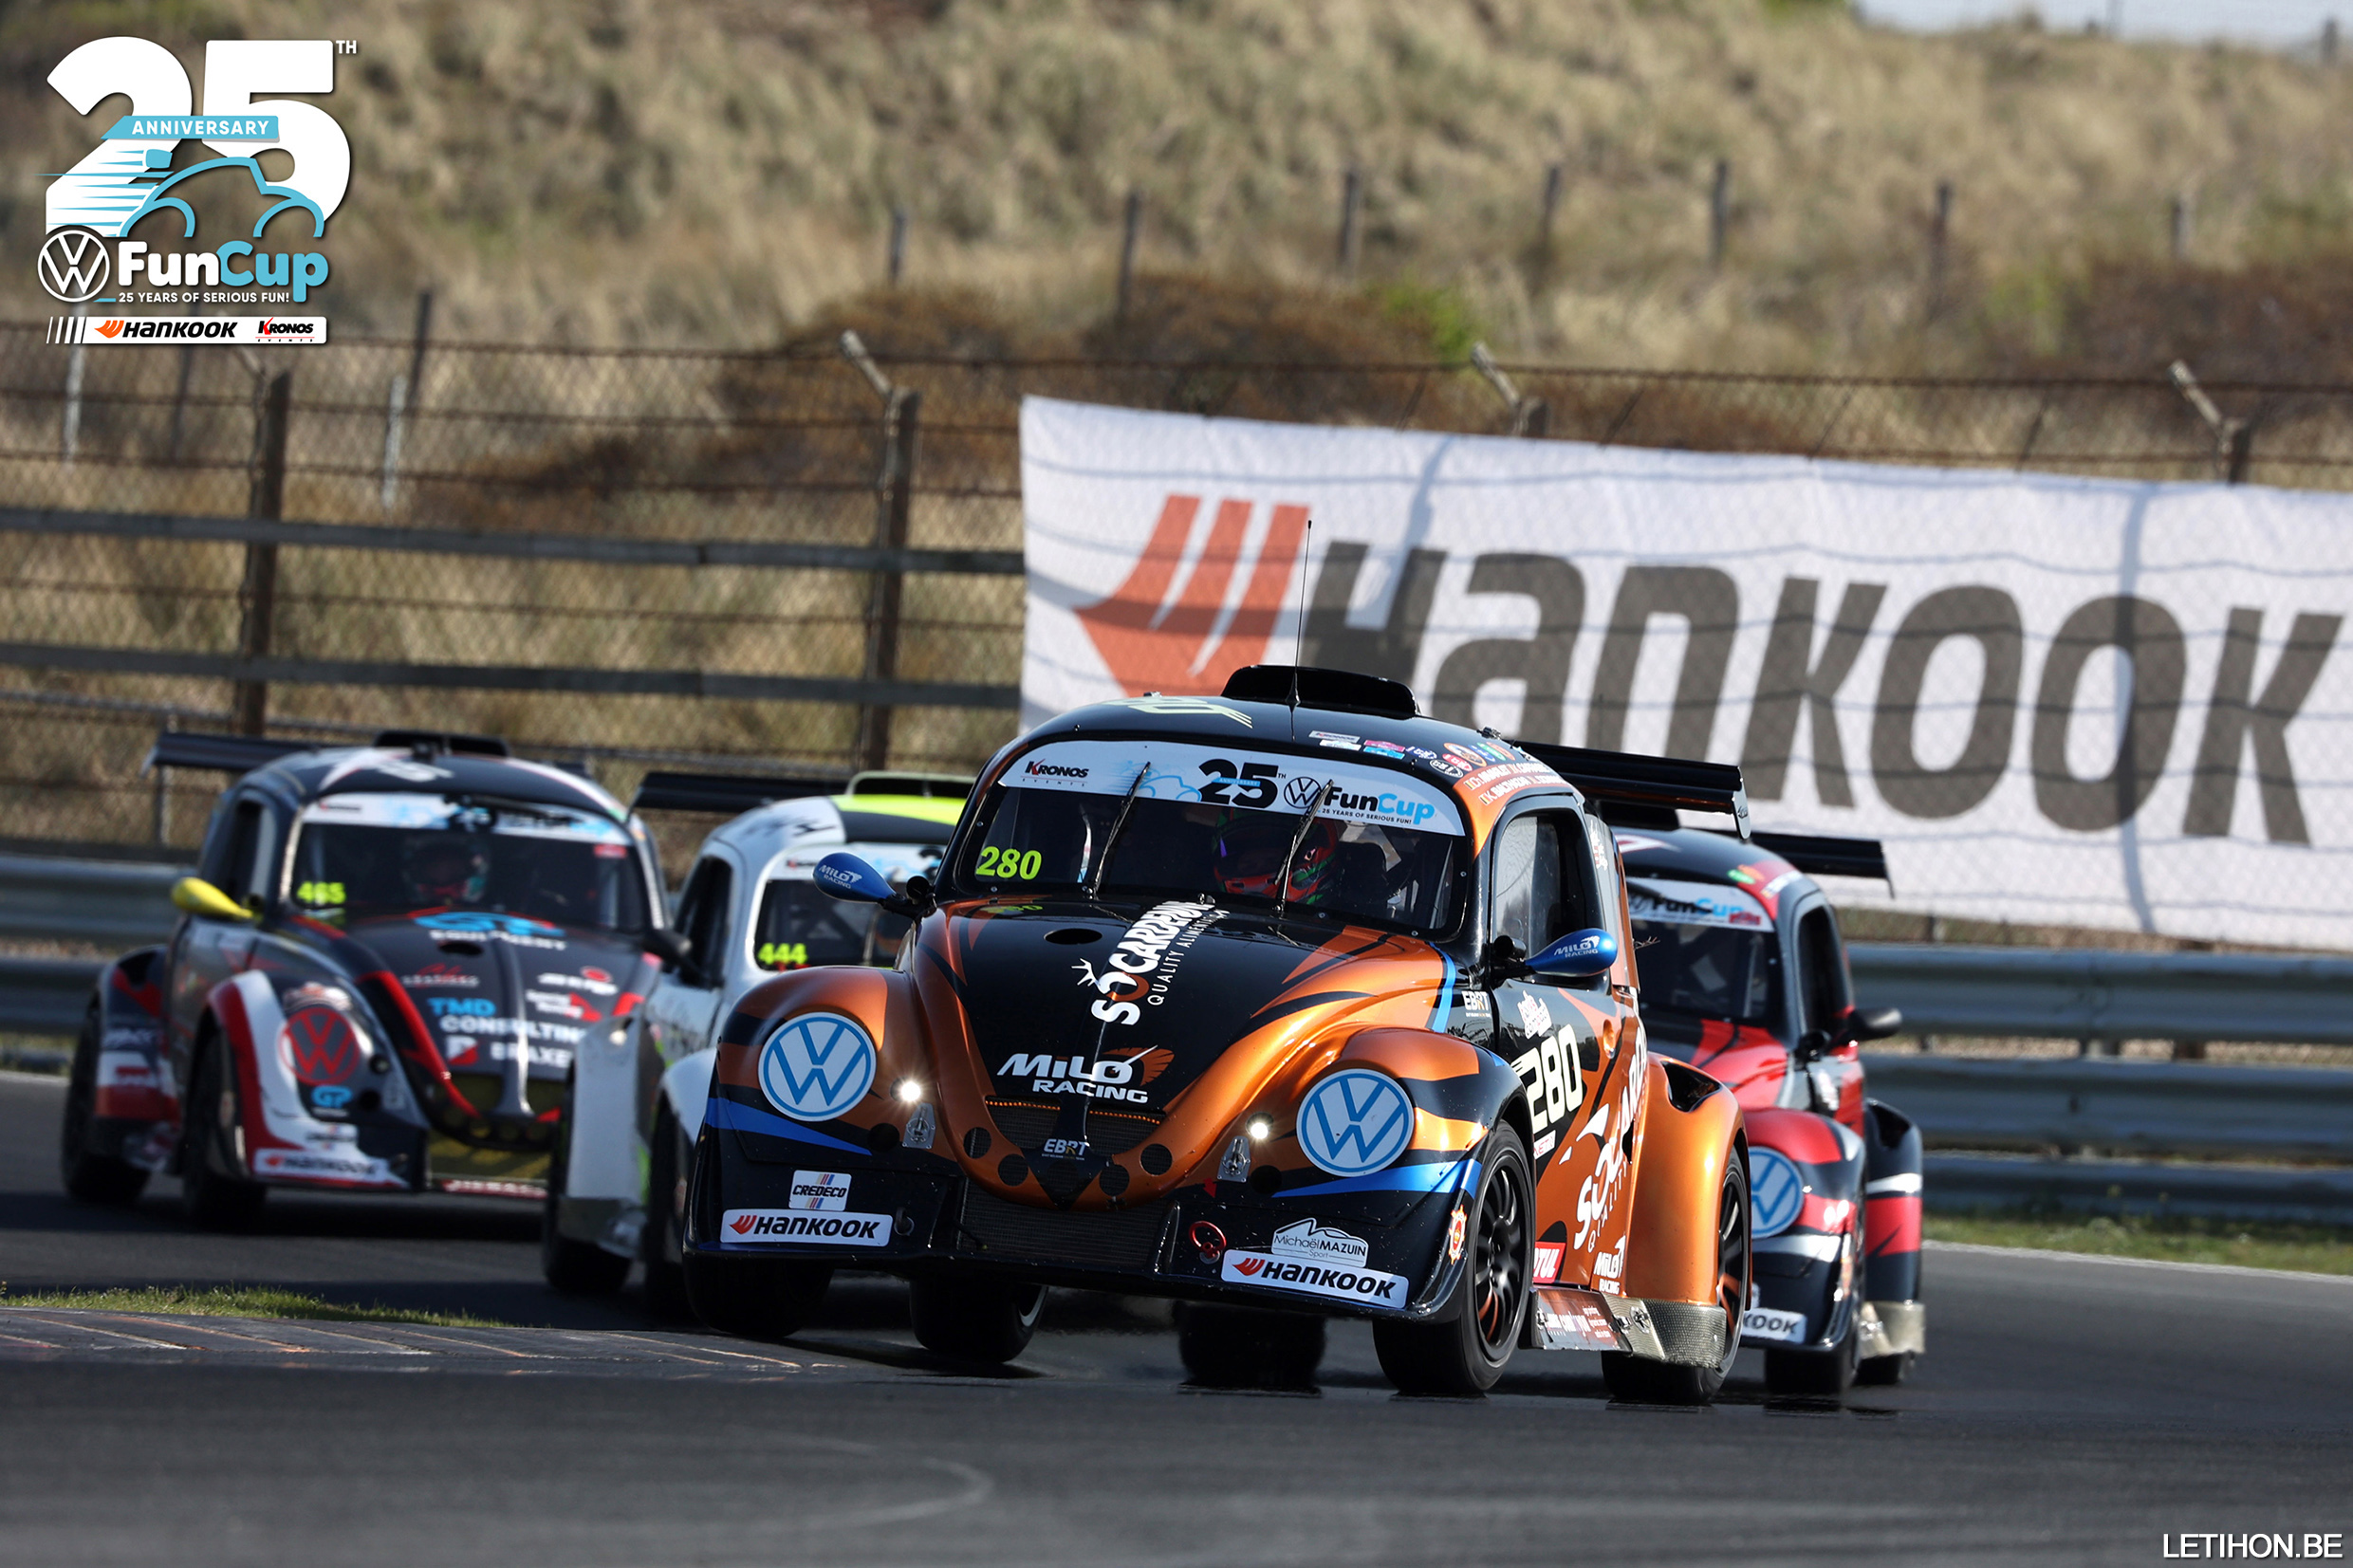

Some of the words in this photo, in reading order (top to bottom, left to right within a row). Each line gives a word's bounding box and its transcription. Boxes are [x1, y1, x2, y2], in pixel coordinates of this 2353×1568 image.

[1025, 759, 1090, 778] KRONOS
[1198, 759, 1279, 808] 25
[1324, 786, 1435, 825] FunCup
[1332, 809, 1353, 818] YEARS
[1366, 813, 1395, 822] SERIOUS
[975, 846, 1043, 880] 280
[824, 875, 852, 889] RACING
[758, 942, 808, 965] 444
[1566, 949, 1599, 958] RACING
[1147, 950, 1185, 1006] QUALITY
[427, 998, 496, 1017] TMD
[1462, 990, 1490, 1011] EBRT
[1510, 1024, 1584, 1134] 280
[1032, 1078, 1149, 1104] RACING
[1044, 1138, 1088, 1156] EBRT
[792, 1183, 847, 1200] CREDECO
[1308, 1248, 1329, 1259] Sport
[1599, 1278, 1621, 1295] RACING
